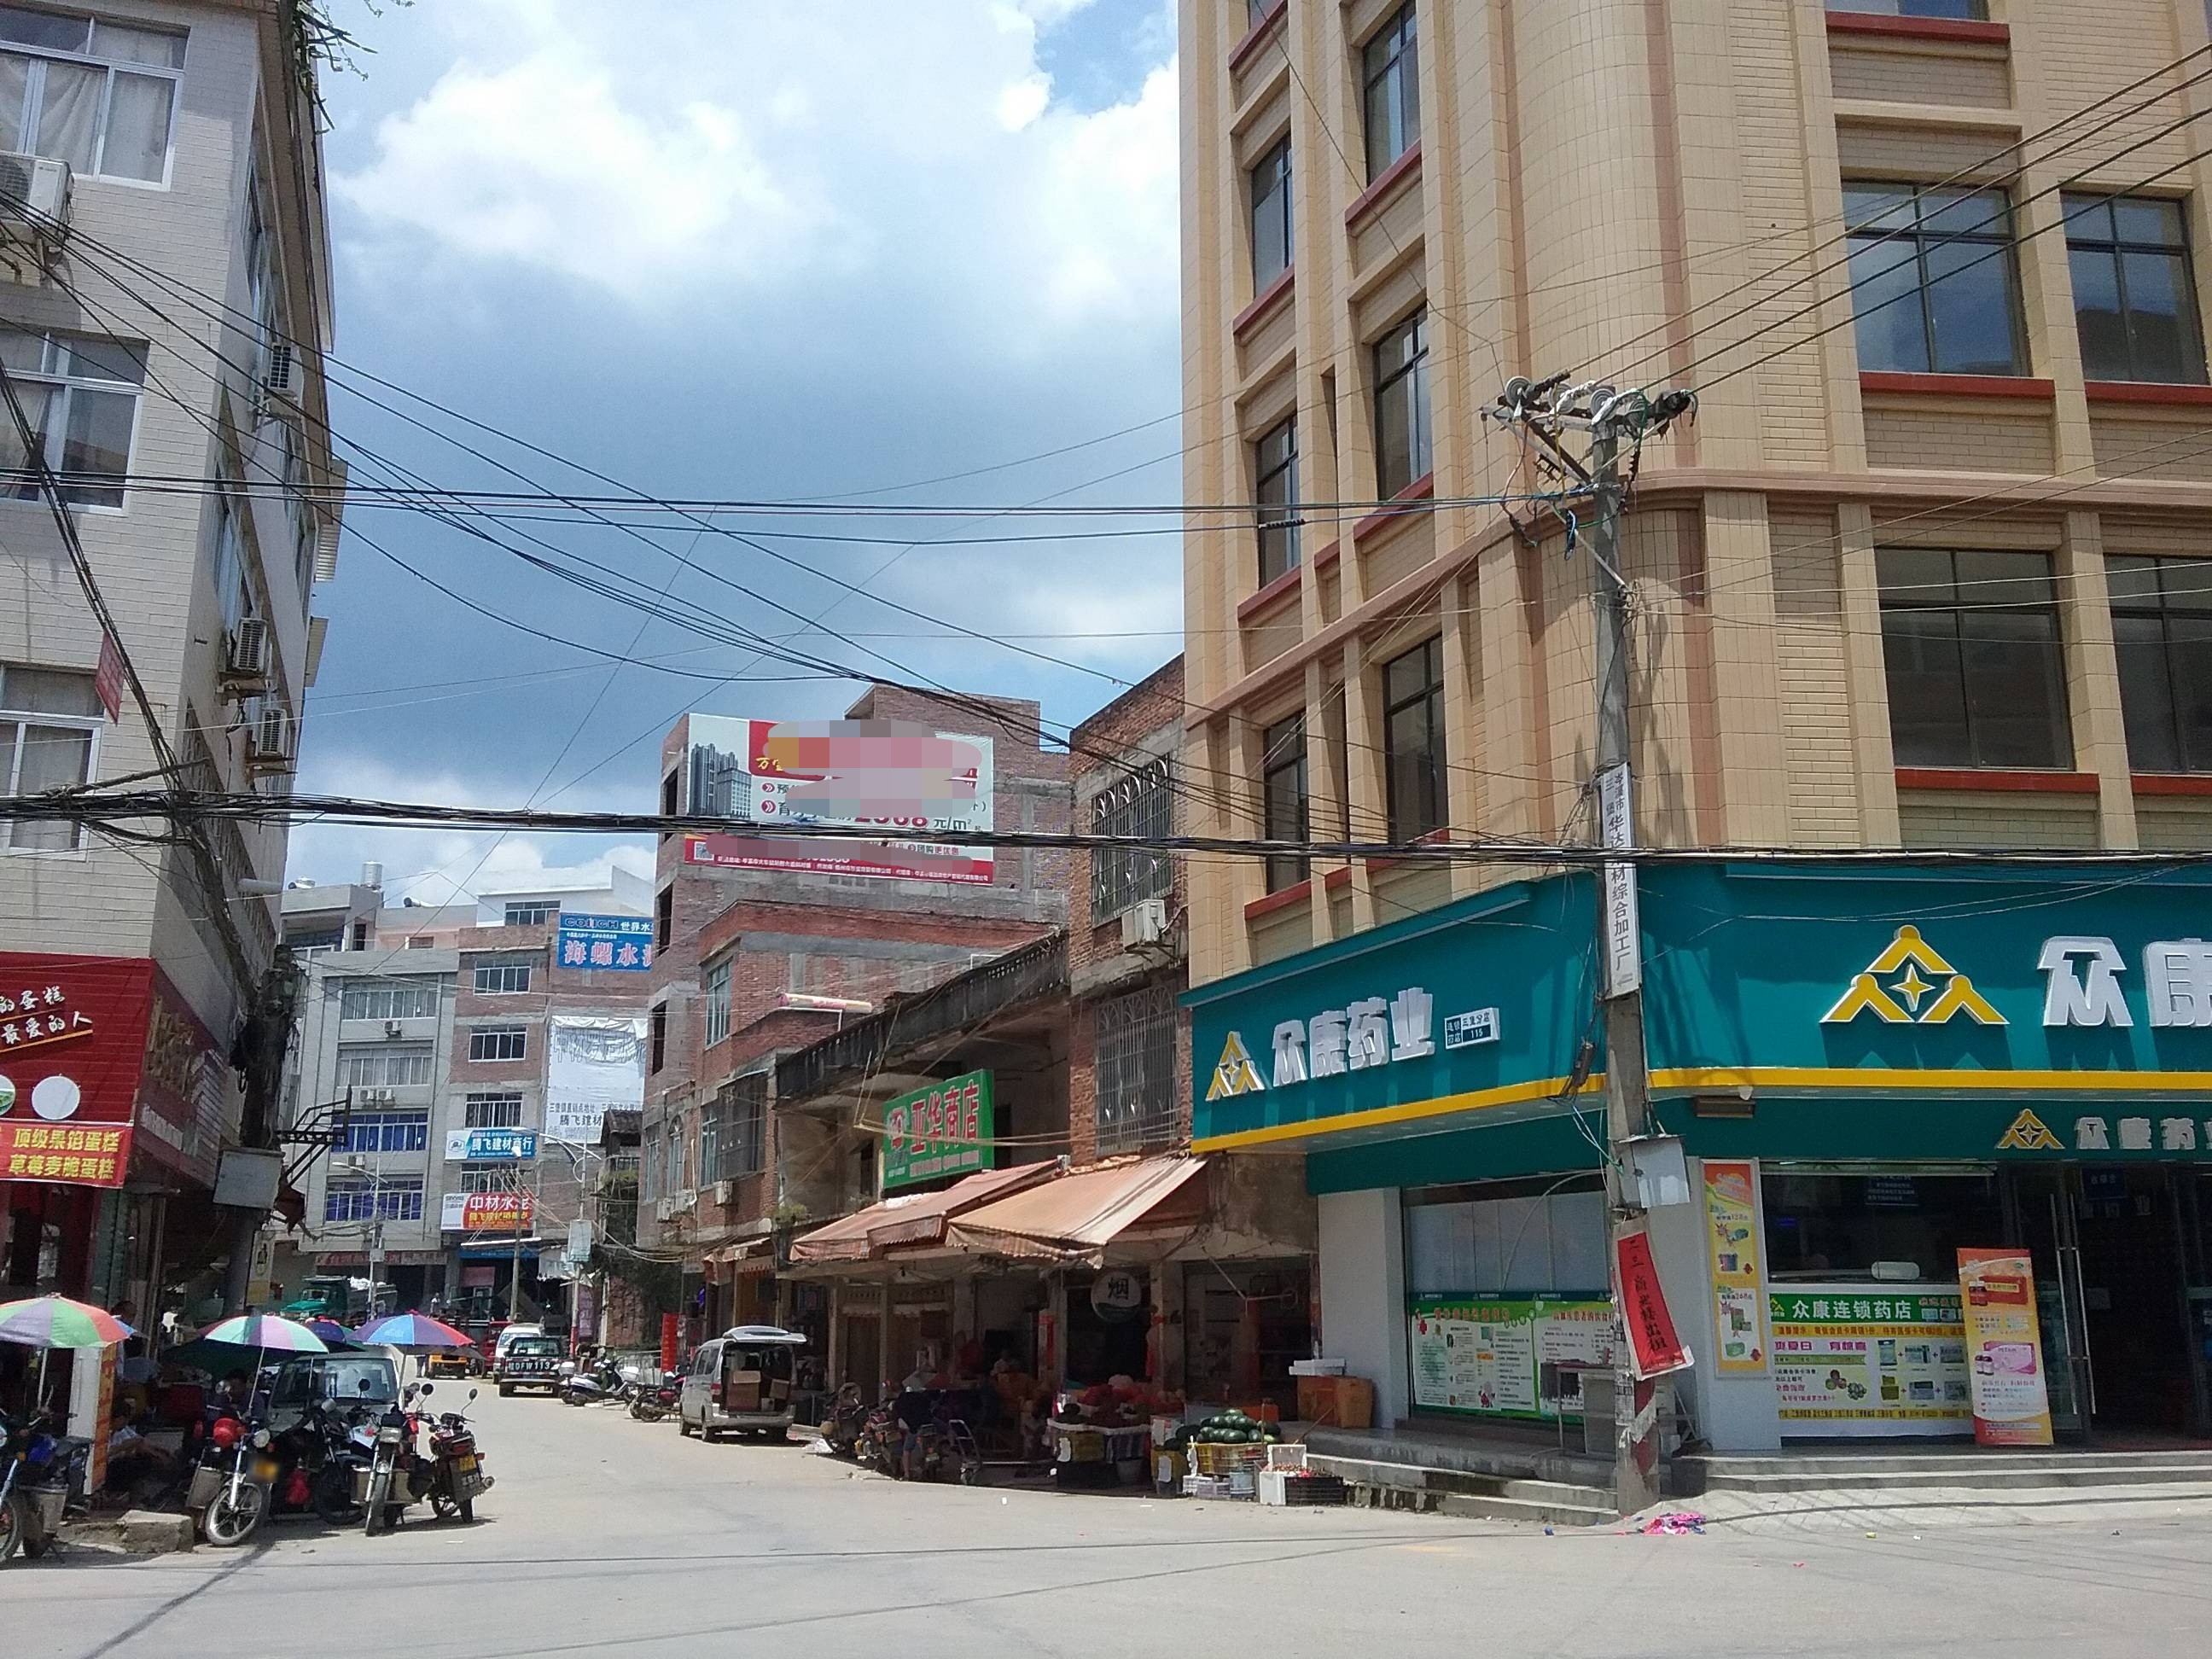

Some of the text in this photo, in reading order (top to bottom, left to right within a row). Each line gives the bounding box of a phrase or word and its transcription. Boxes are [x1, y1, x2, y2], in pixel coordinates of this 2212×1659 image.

[1608, 814, 1631, 971] 华达材综合加工厂
[620, 922, 655, 932] 世界水
[1272, 987, 1435, 1088] 众康药业
[1470, 1027, 1484, 1039] 115
[13, 1128, 119, 1153] 顶级果馅蛋糕
[2075, 1116, 2212, 1150] 众康药
[9, 1153, 116, 1179] 草莓麦脆蛋糕
[1792, 1299, 1912, 1319] 众康连锁药店
